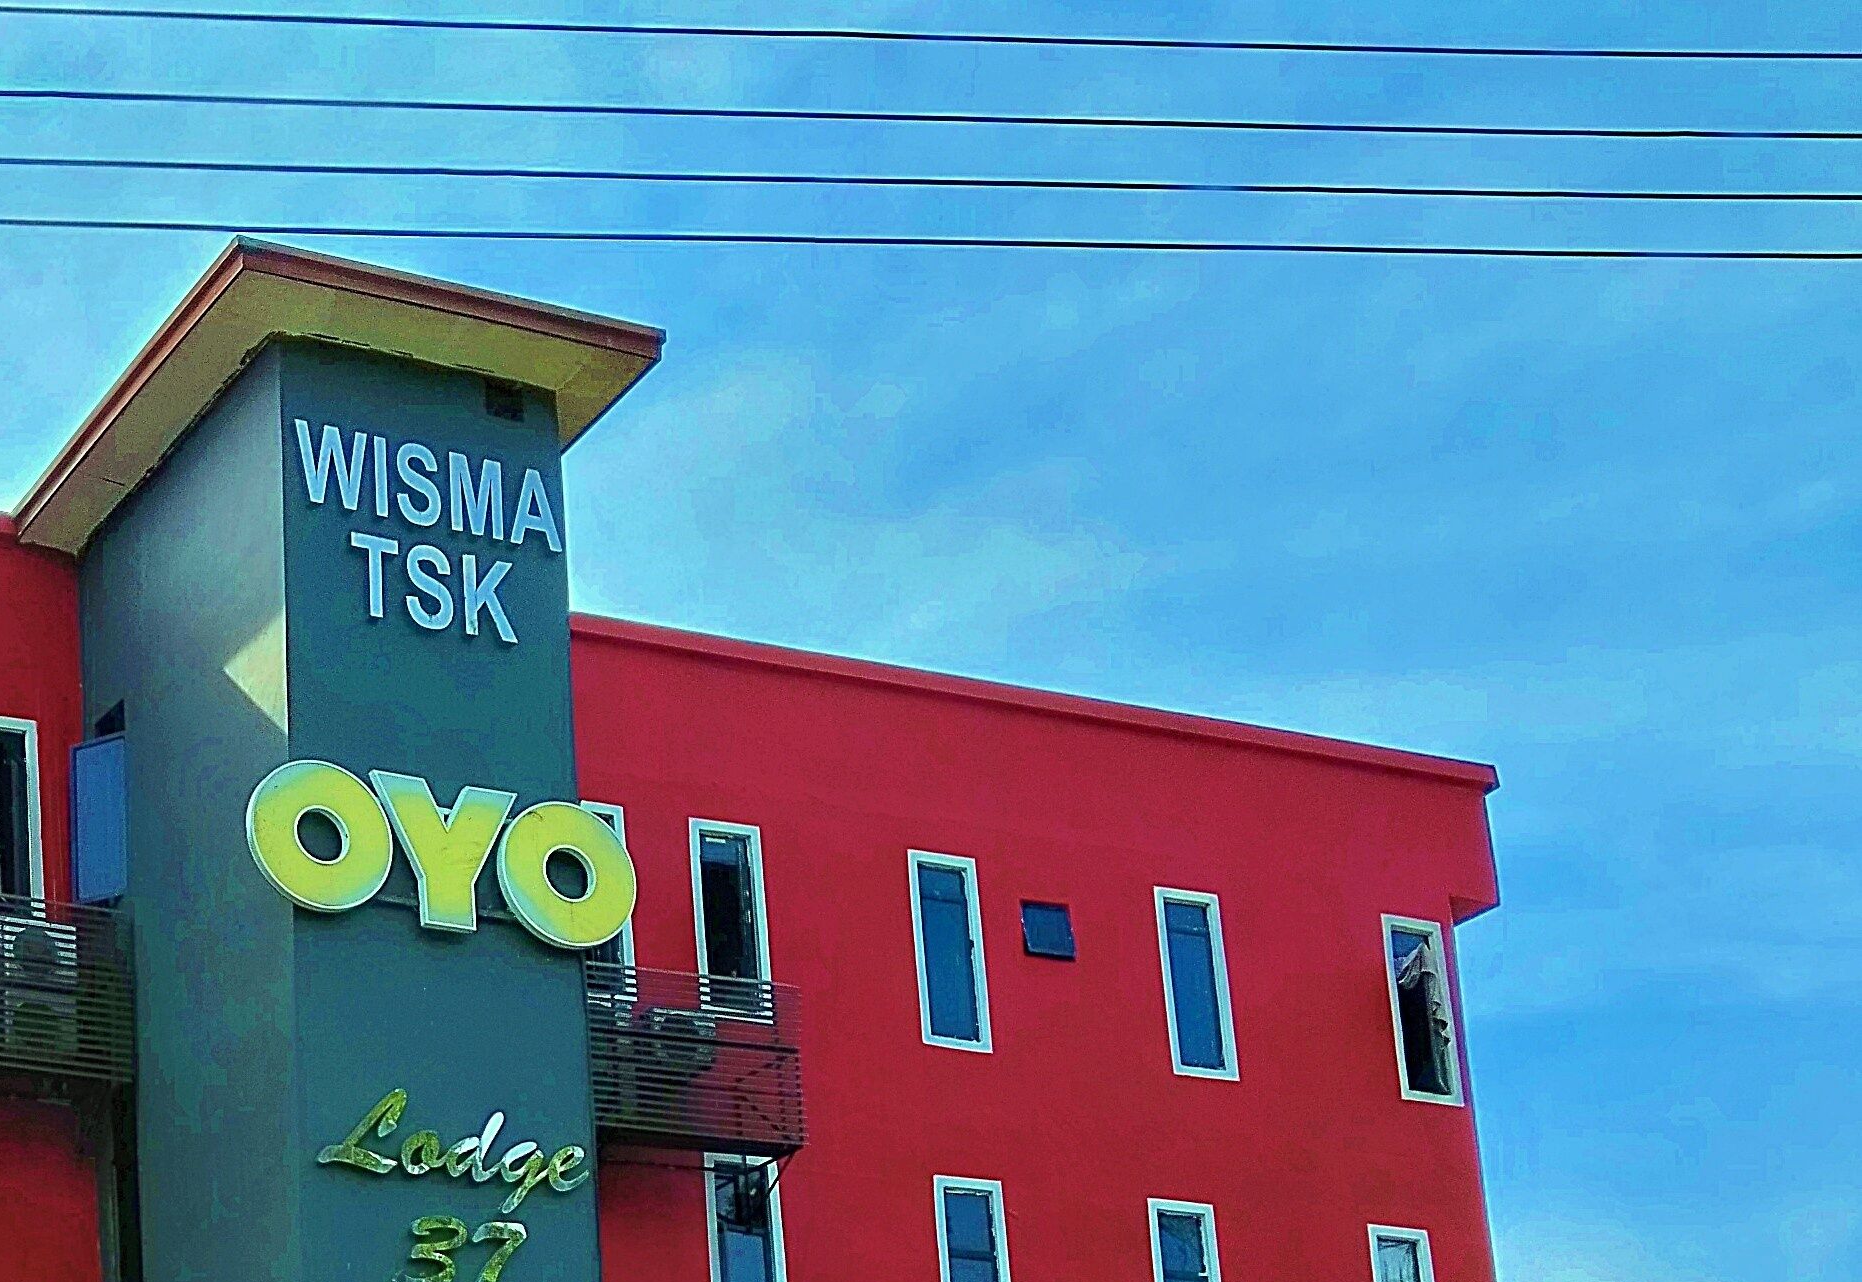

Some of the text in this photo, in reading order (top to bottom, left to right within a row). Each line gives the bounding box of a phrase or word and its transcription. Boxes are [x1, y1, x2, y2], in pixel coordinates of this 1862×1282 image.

[294, 419, 562, 553] WISMA
[350, 531, 518, 644] TSK
[245, 759, 637, 949] OYO
[317, 1088, 589, 1213] Lodge
